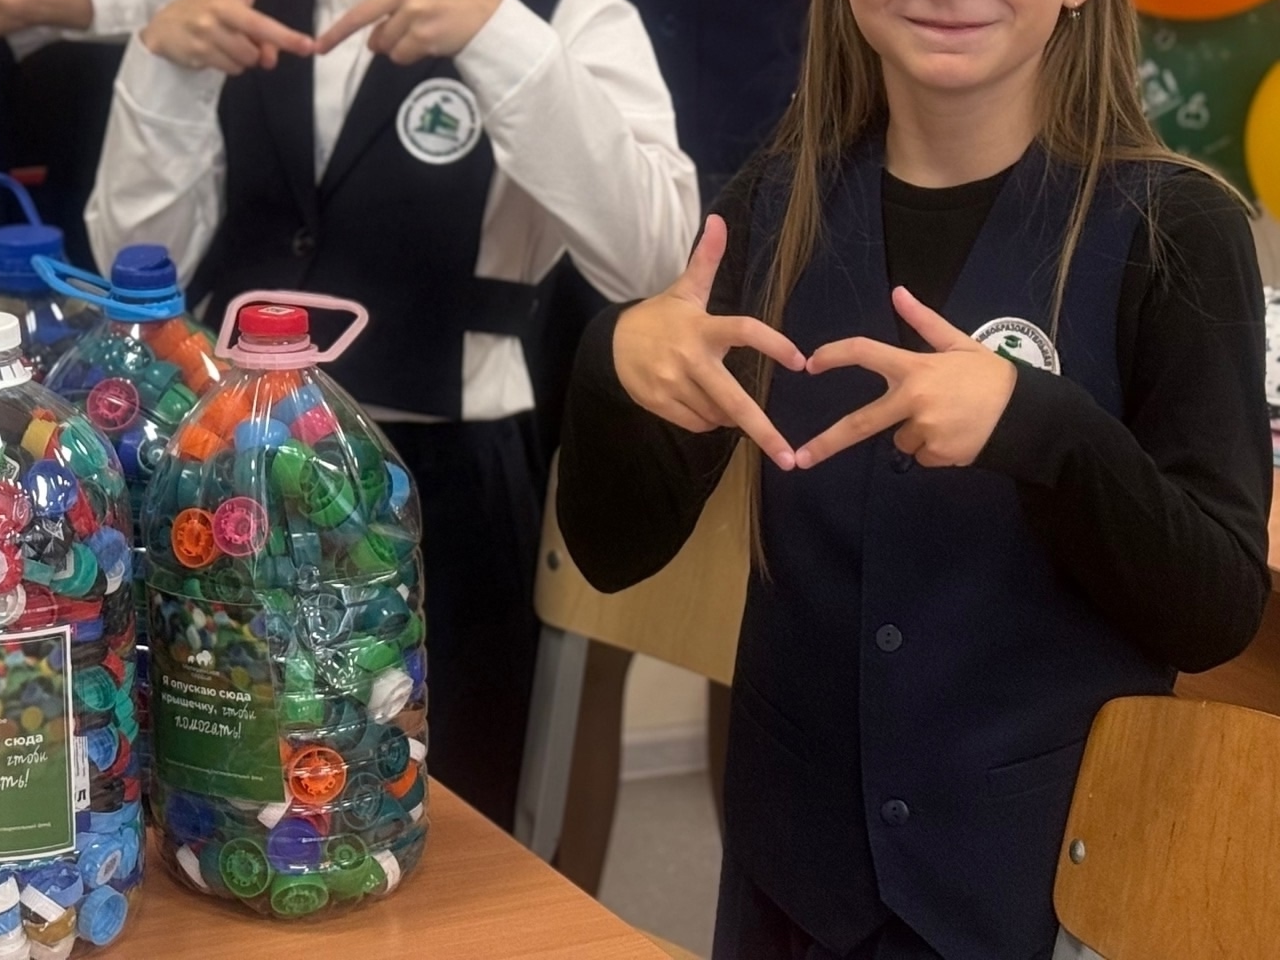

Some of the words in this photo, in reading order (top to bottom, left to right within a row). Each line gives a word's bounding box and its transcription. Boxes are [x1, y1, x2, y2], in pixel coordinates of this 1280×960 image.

[170, 680, 217, 696] опускаю
[219, 689, 252, 703] сюда
[174, 715, 242, 739] помогать!
[4, 734, 43, 747] сюда
